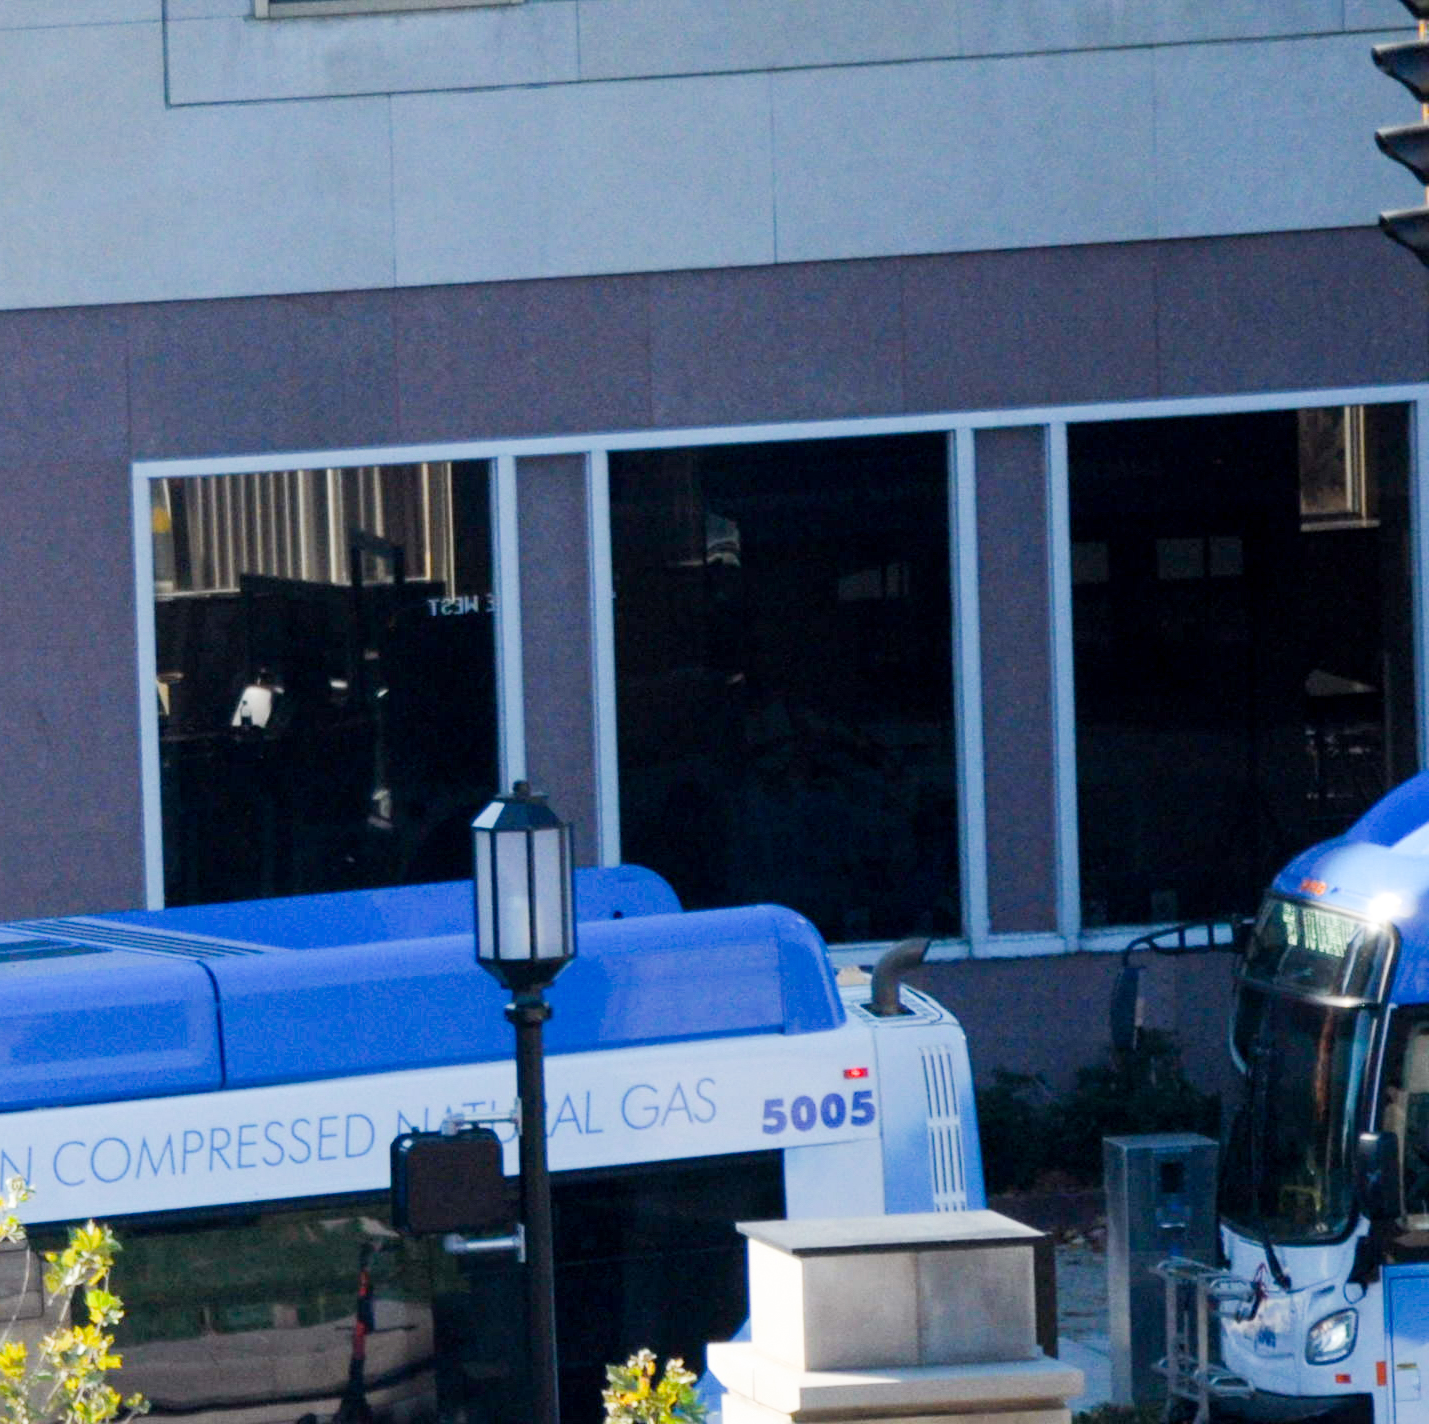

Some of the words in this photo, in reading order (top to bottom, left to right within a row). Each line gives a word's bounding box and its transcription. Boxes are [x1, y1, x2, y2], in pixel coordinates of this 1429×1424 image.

[53, 1113, 376, 1186] COMPRESSED
[397, 1090, 604, 1144] NTUAL
[620, 1077, 717, 1131] GAS
[761, 1089, 877, 1136] 5005
